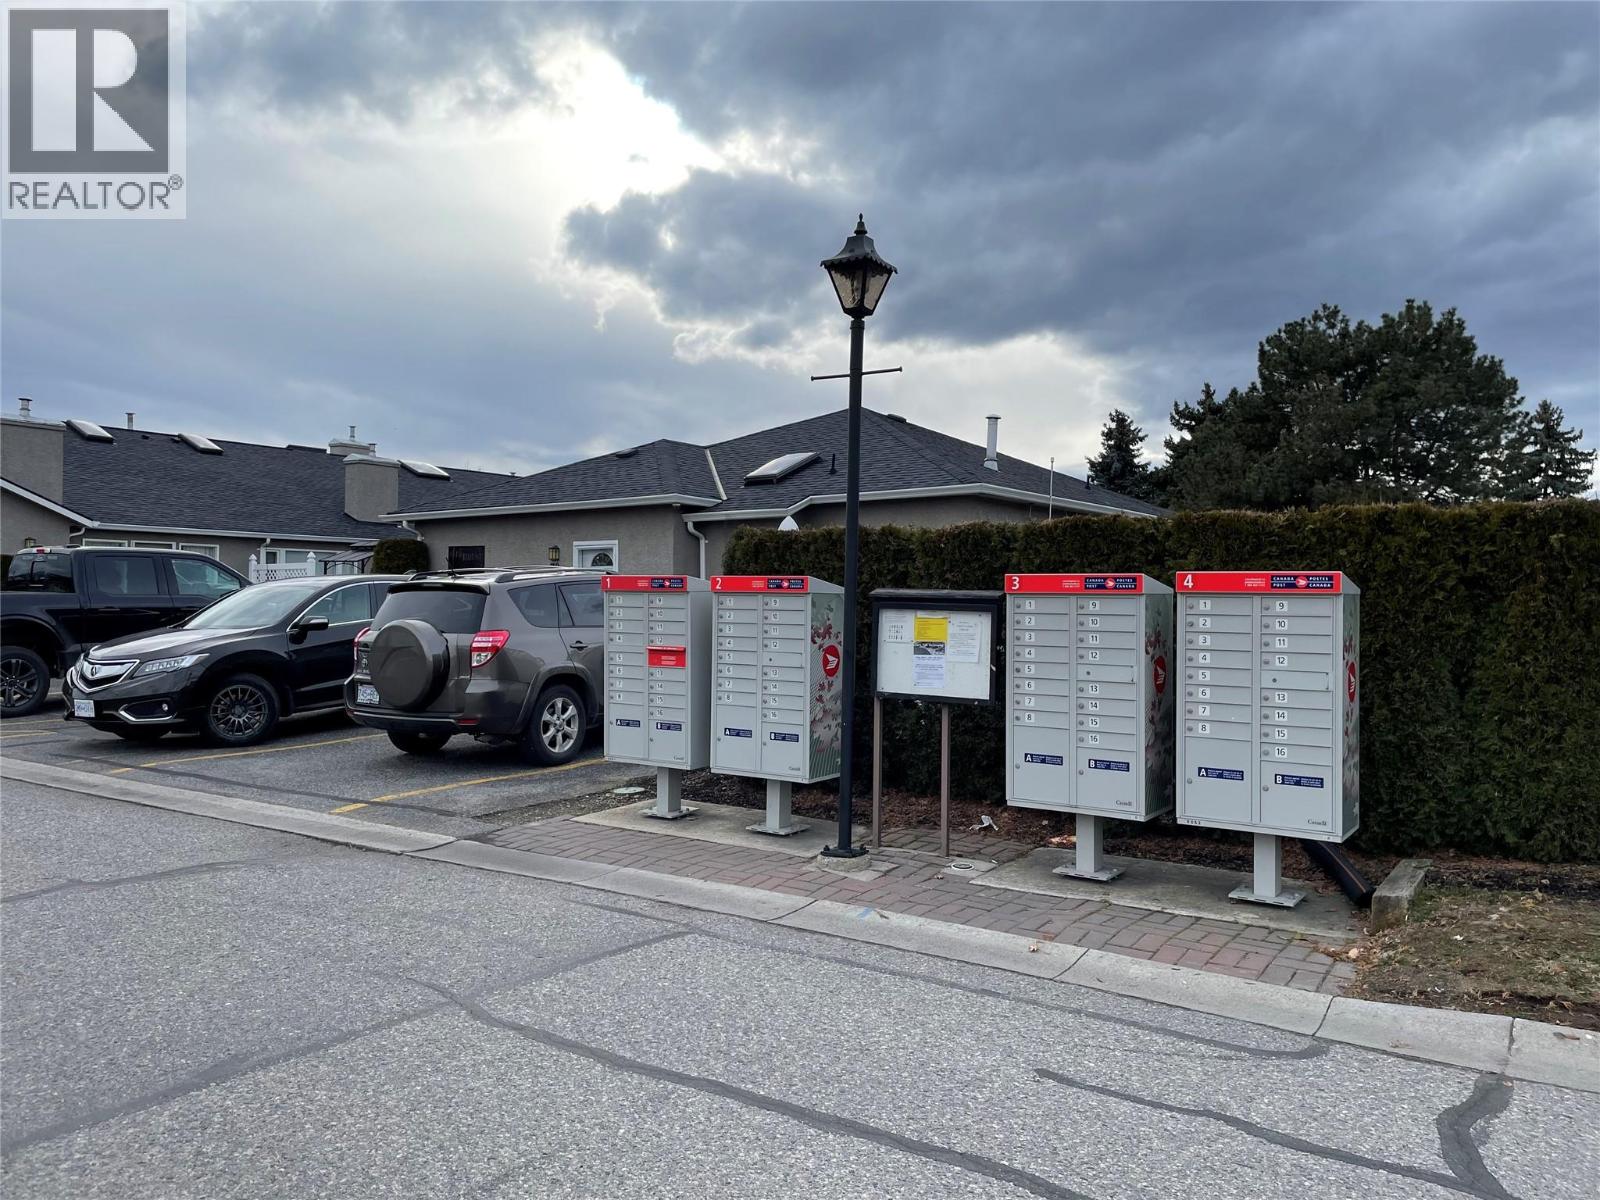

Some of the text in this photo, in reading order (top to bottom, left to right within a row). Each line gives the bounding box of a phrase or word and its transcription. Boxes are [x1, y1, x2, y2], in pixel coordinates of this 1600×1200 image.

[606, 577, 610, 588] 1
[716, 578, 722, 589] 2
[1012, 576, 1020, 590] 3
[1183, 574, 1194, 588] 4
[1201, 636, 1207, 644] 3
[1276, 711, 1285, 719] 14
[1276, 729, 1286, 738] 15
[1276, 748, 1286, 756] 16
[1025, 754, 1032, 762] A
[1199, 768, 1207, 777] A
[1276, 775, 1282, 784] B
